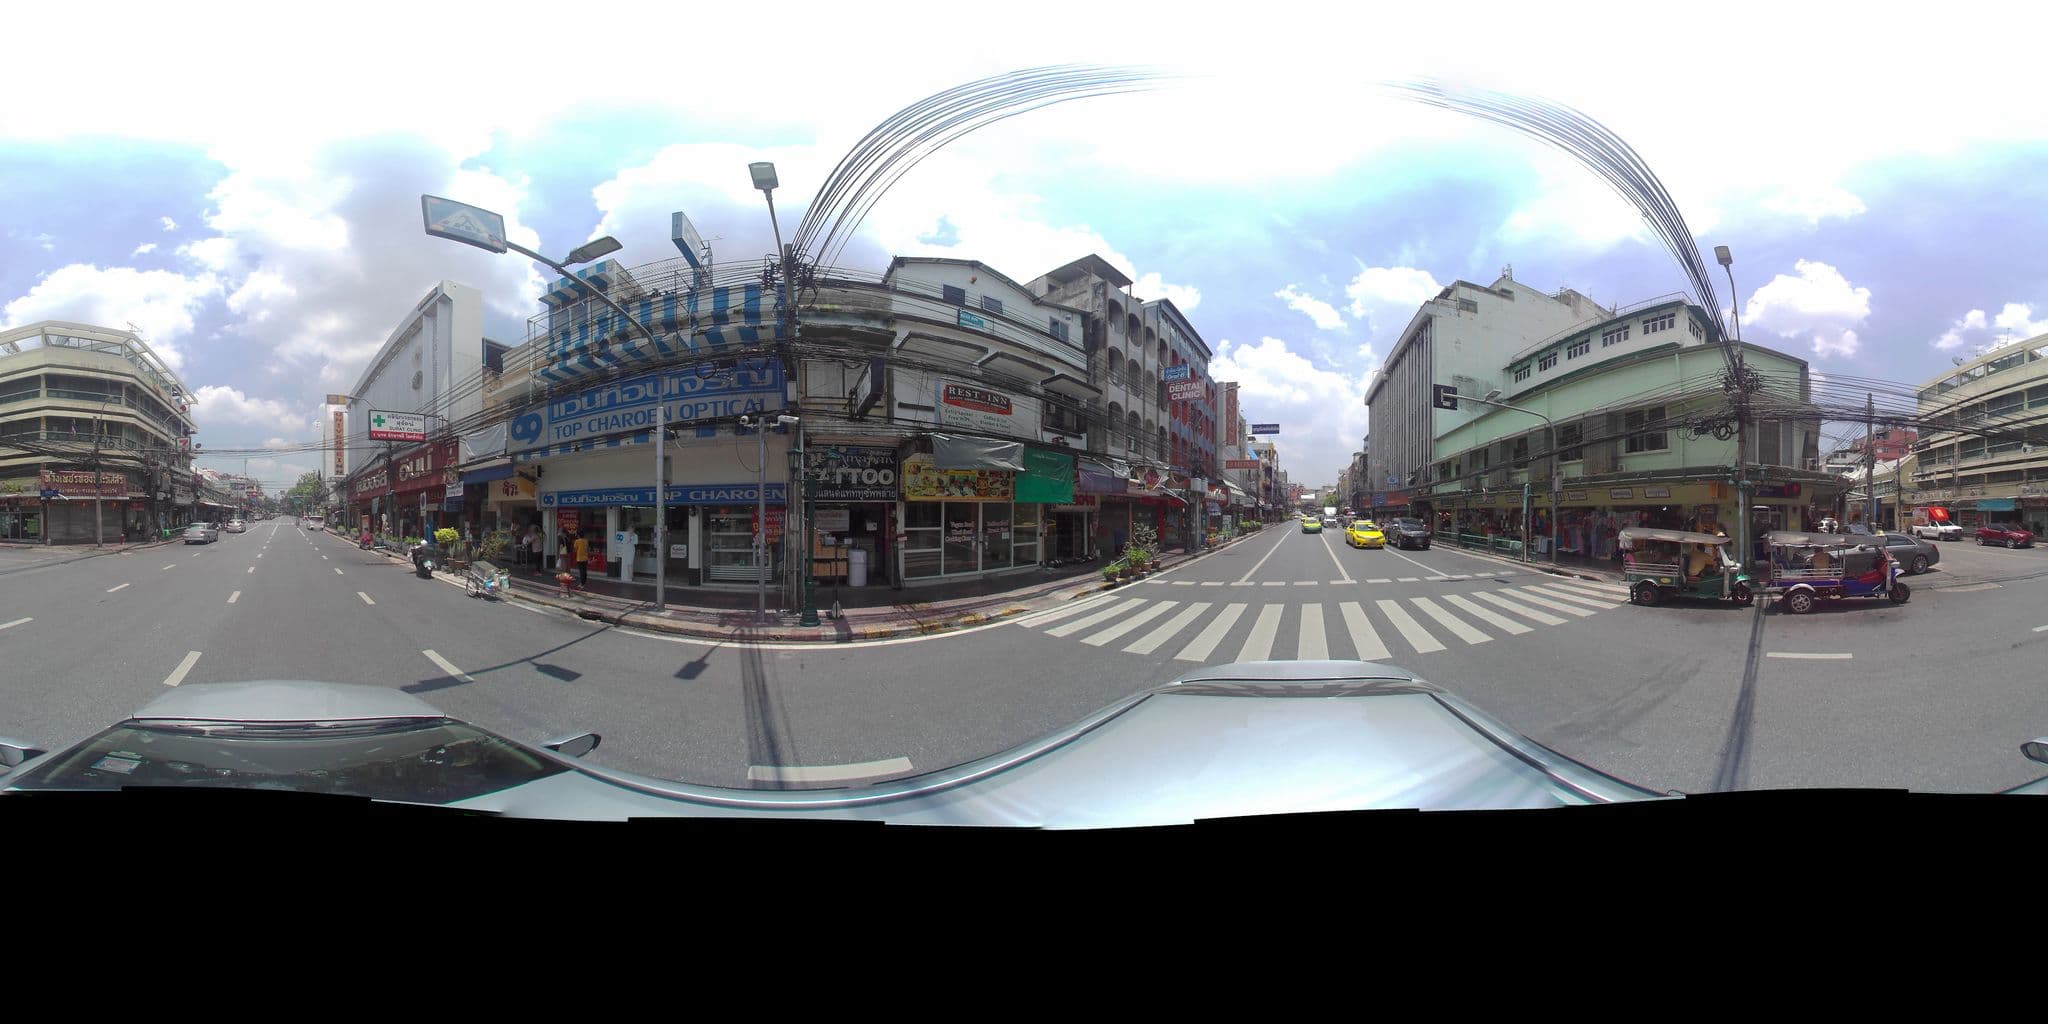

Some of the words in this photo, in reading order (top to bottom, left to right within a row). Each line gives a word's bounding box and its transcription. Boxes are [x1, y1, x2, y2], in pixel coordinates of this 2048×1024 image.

[1169, 382, 1200, 393] DENTAL
[949, 386, 980, 399] REST
[987, 393, 1008, 407] INN
[1171, 390, 1201, 400] CLINIC
[555, 422, 582, 440] TOP
[588, 405, 672, 433] CHAROEN
[679, 397, 765, 420] OPTICAL
[689, 488, 785, 501] CHAROEN
